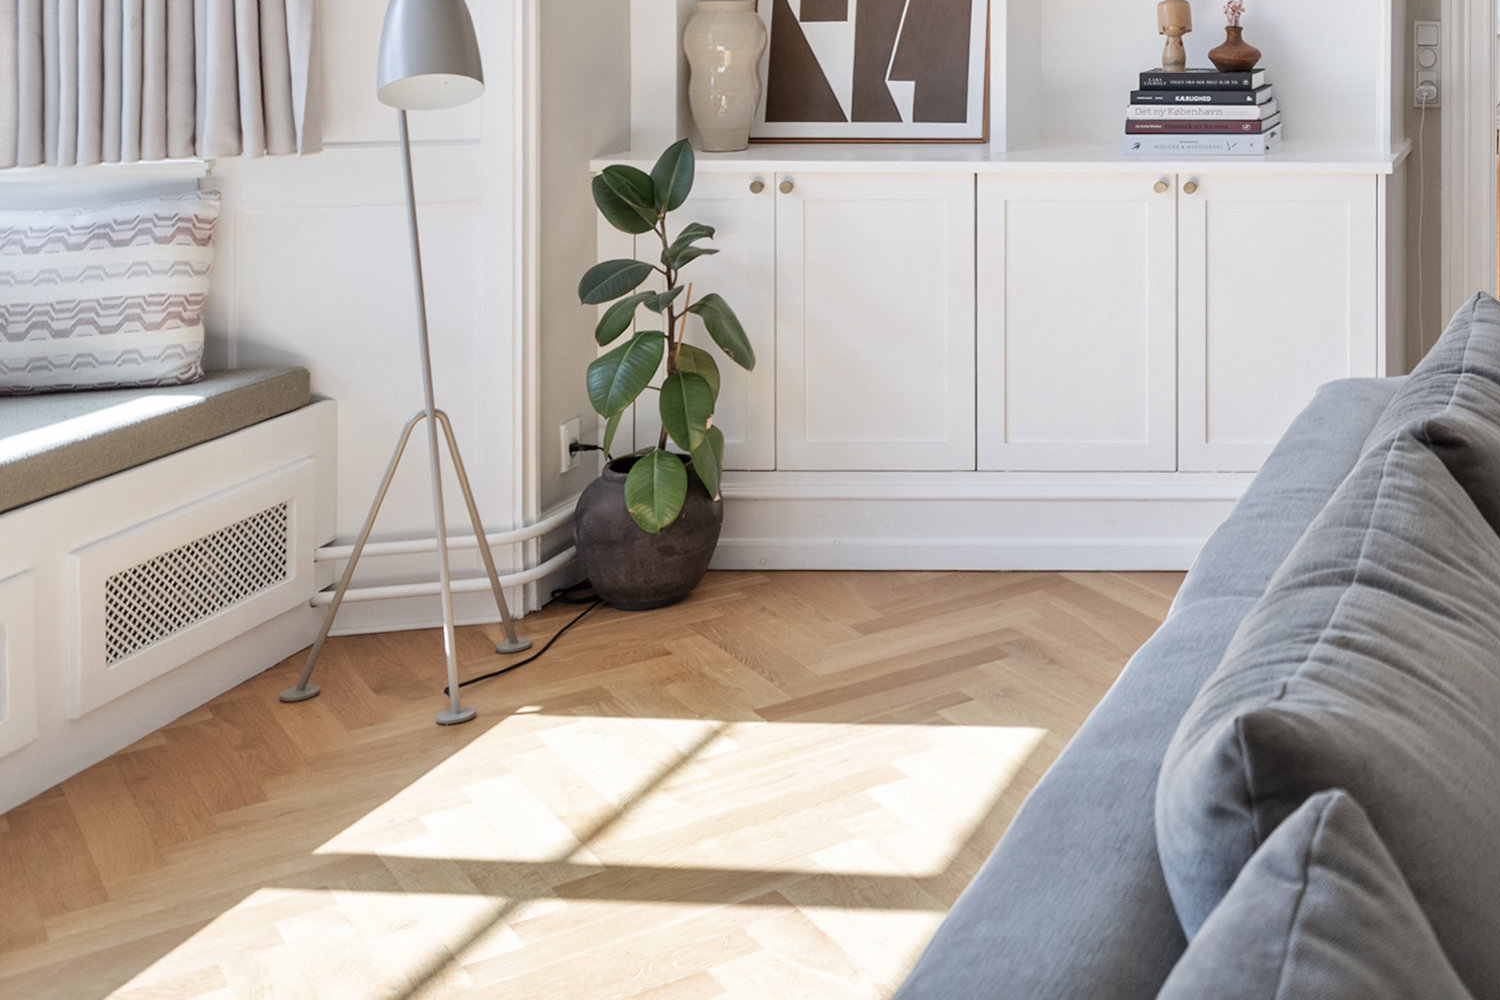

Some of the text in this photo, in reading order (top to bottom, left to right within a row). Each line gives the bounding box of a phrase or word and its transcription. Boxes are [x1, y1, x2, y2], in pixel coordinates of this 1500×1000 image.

[1135, 107, 1222, 117] Det ny København
